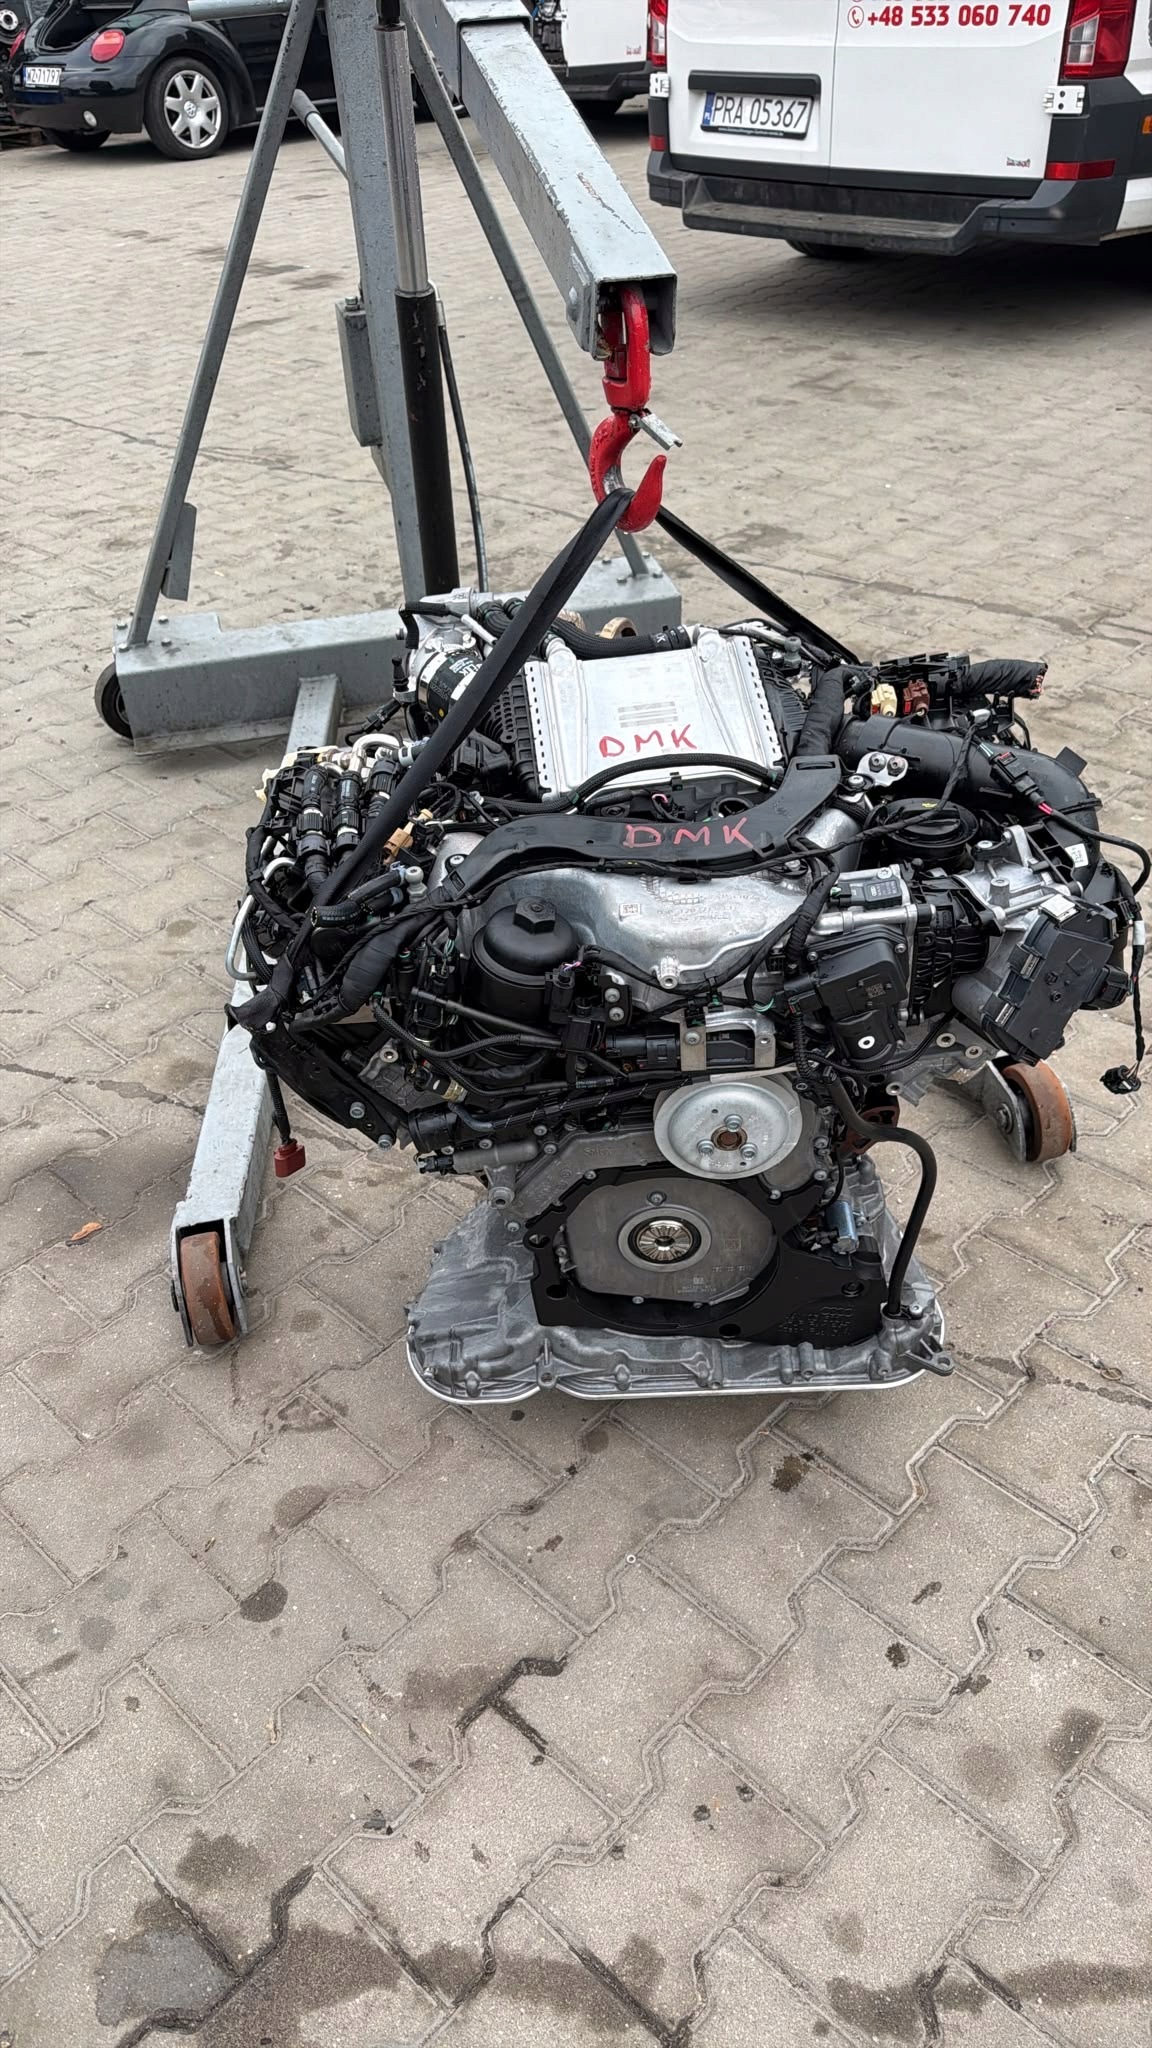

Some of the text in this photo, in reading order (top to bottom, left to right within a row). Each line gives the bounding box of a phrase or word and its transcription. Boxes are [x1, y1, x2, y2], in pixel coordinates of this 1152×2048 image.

[867, 4, 1051, 27] +48 533 060 740
[38, 69, 60, 83] 71797
[712, 95, 809, 129] PRA 05367
[599, 724, 698, 758] DMK
[622, 817, 754, 849] DMK
